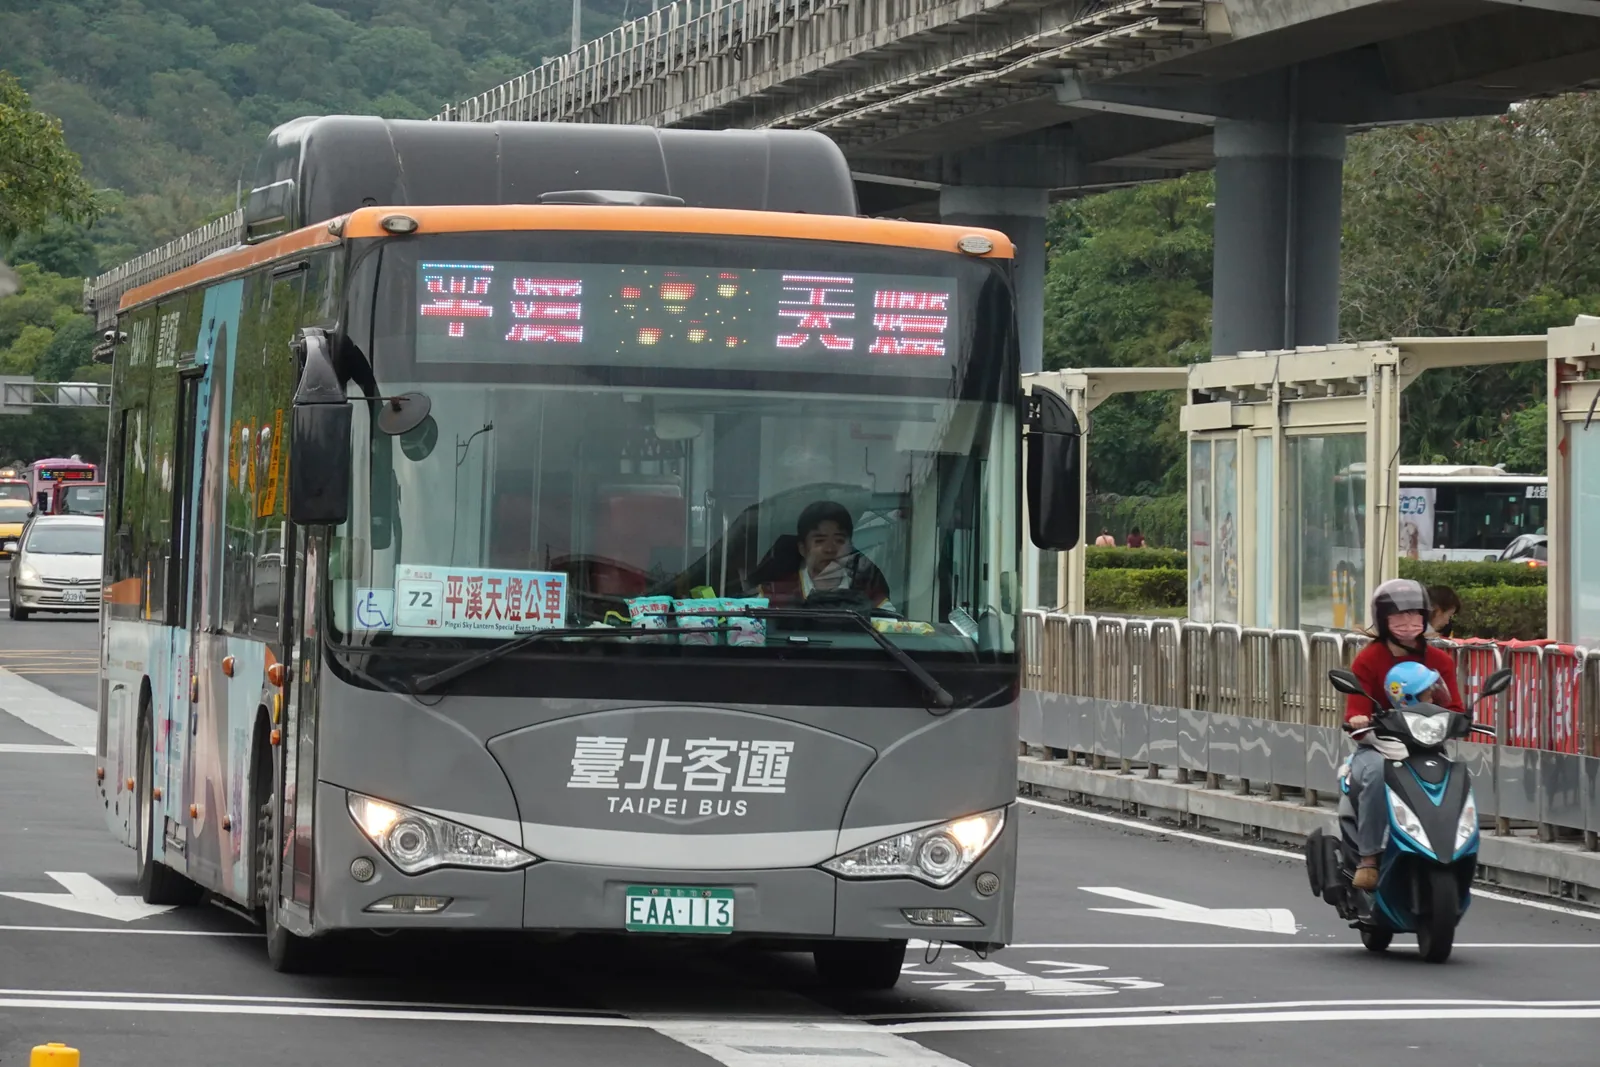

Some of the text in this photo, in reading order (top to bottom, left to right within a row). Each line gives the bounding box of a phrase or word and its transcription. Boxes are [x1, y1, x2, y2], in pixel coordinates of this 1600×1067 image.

[408, 591, 433, 607] 72
[445, 574, 563, 624] 平溪天燈公車
[444, 620, 462, 629] Pingxi
[462, 621, 472, 630] Sky
[473, 622, 494, 630] Lantern
[495, 622, 515, 632] Special
[566, 736, 795, 793] 臺北客運
[607, 796, 748, 816] TAIPEI BUS
